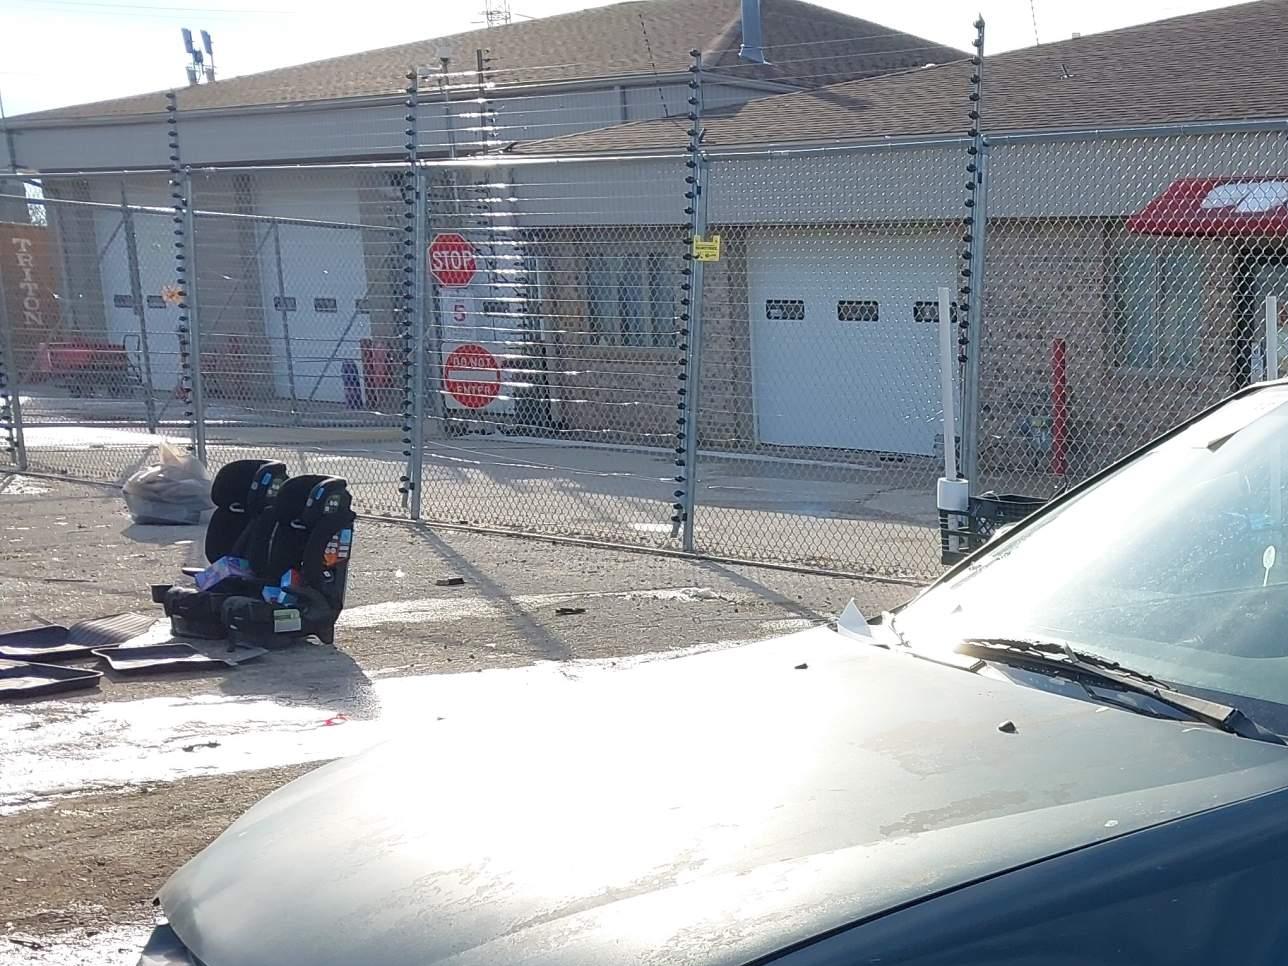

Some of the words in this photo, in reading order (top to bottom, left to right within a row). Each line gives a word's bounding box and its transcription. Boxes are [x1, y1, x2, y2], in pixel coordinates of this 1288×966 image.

[432, 250, 473, 272] STOP
[12, 237, 44, 326] TRITON
[453, 304, 466, 322] 5
[452, 356, 467, 367] DO
[469, 357, 492, 368] NOT
[456, 384, 492, 396] ENTER
